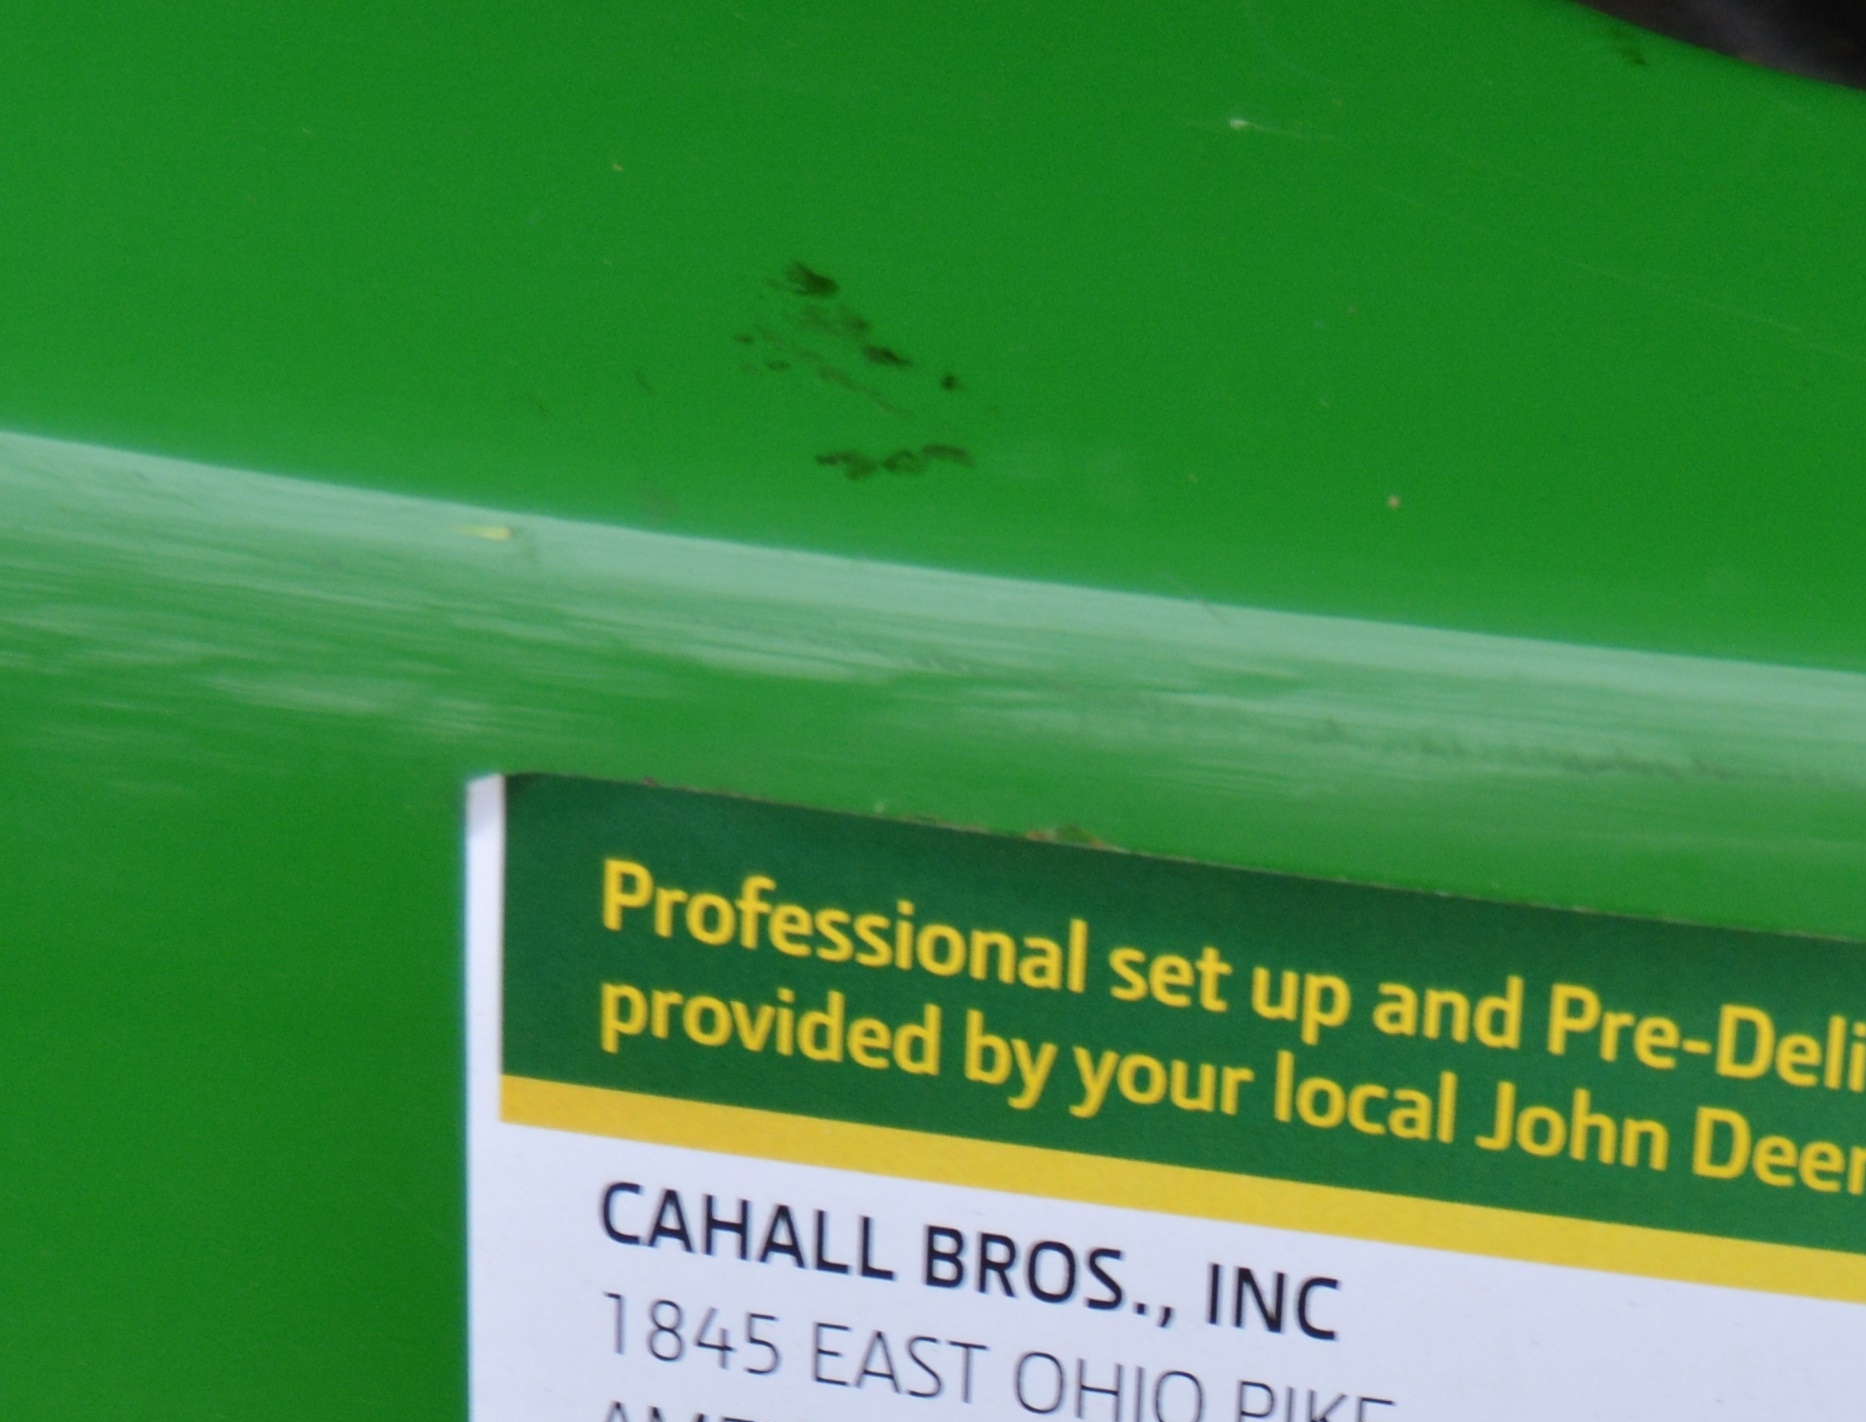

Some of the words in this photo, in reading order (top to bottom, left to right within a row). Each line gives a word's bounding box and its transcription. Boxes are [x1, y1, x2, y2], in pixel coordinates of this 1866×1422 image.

[603, 859, 1088, 993] Professional
[1110, 947, 1232, 1011] set
[1252, 966, 1351, 1045] up
[1373, 976, 1524, 1049] and
[601, 982, 941, 1076] provided
[965, 1010, 1058, 1110] by
[1069, 1046, 1254, 1118] your
[1274, 1050, 1458, 1143] local
[1476, 1082, 1669, 1170] John
[600, 1181, 896, 1283] CAHALL
[924, 1225, 1174, 1328] BROS.,
[1208, 1263, 1342, 1341] INC
[603, 1292, 781, 1375] 1845
[813, 1321, 987, 1405] EAST
